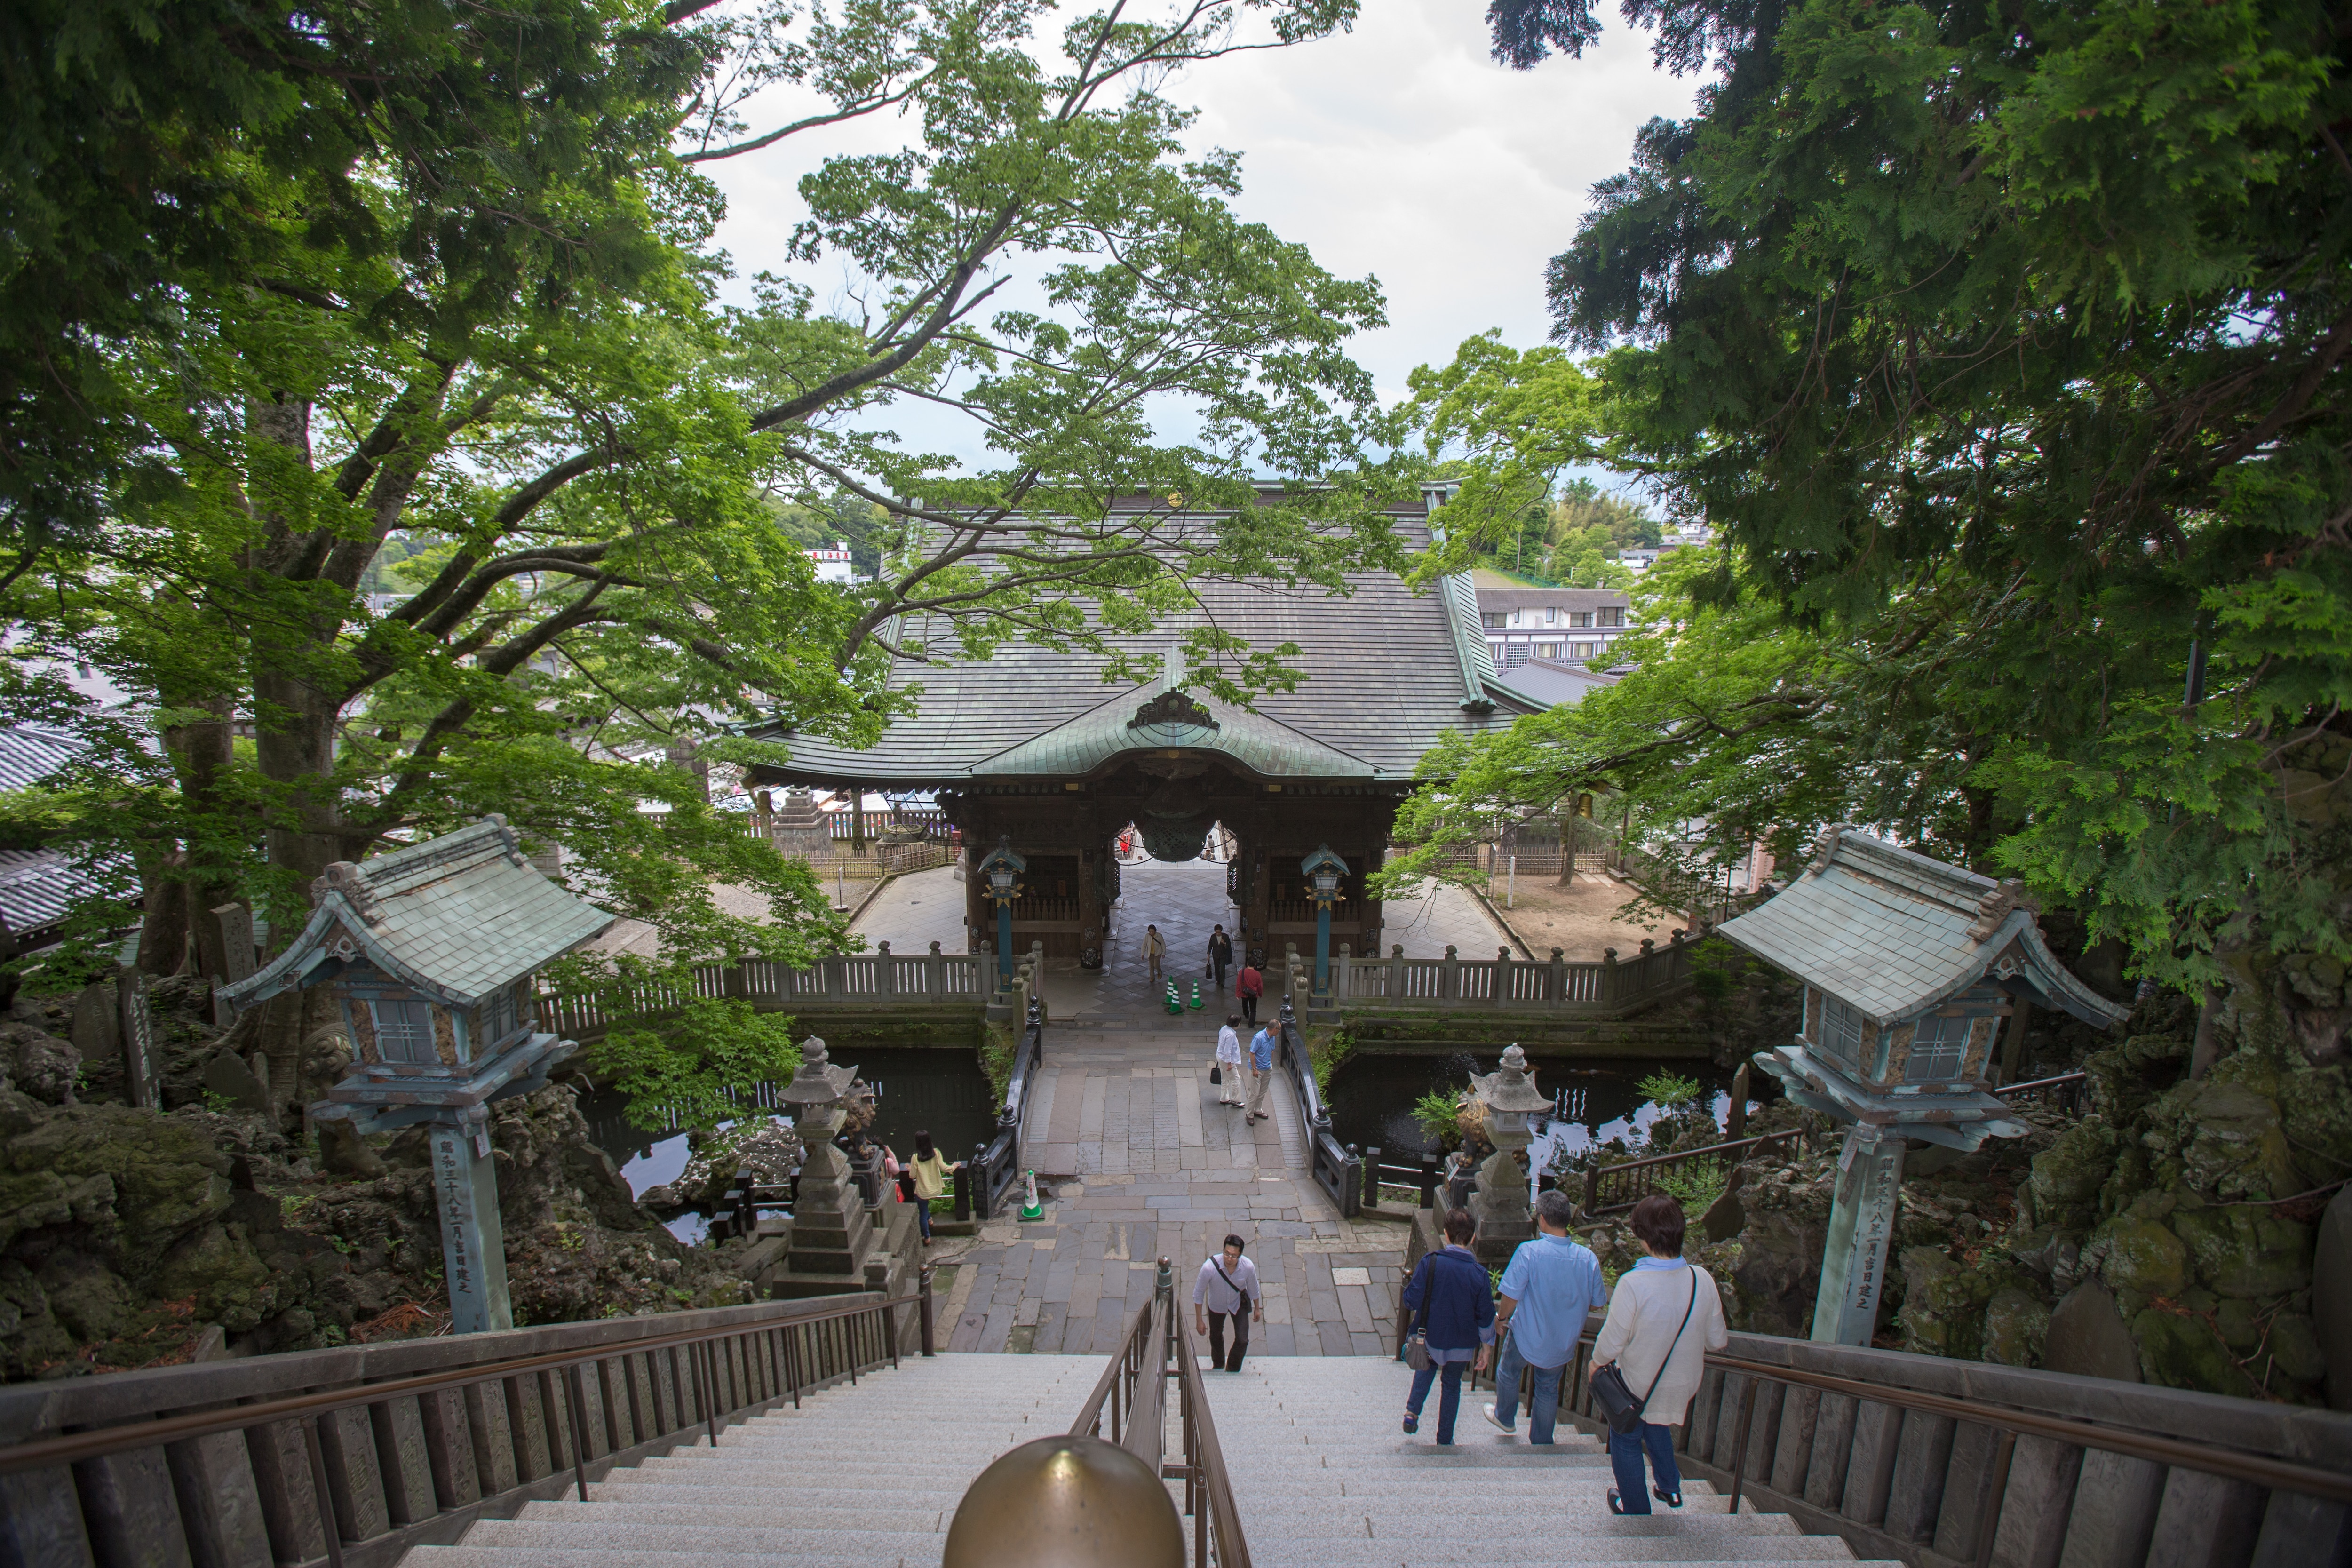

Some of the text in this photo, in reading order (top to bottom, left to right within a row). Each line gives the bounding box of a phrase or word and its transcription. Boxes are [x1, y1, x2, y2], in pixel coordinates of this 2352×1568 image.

[440, 1140, 472, 1294] 昭和三十八年一月吉日建之
[1856, 1157, 1894, 1310] 昭和三十八年一月吉日建之
